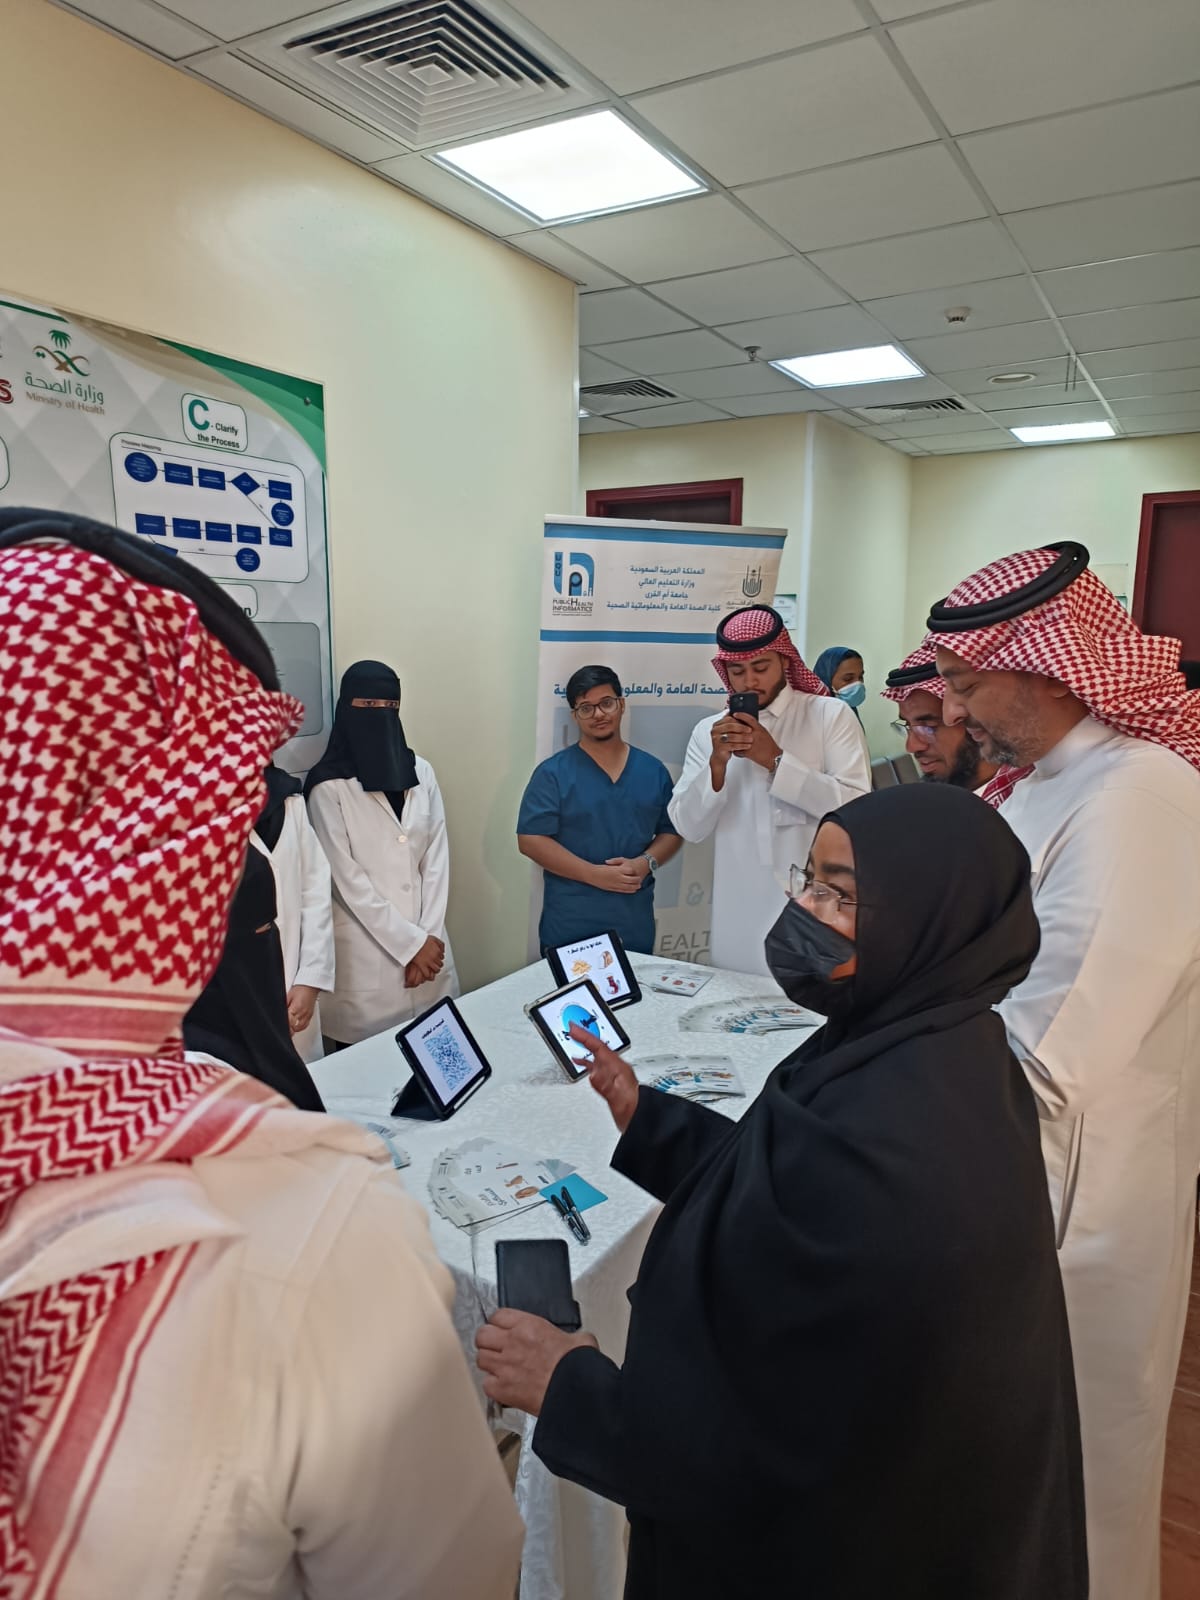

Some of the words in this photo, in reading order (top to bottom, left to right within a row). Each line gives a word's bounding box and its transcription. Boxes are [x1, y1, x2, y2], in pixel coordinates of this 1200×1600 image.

[25, 371, 71, 394] الصحة
[75, 383, 104, 405] وزارة
[26, 391, 63, 408] Ministry
[77, 403, 105, 415] Health
[188, 399, 210, 430] C
[215, 423, 239, 436] Clarify
[197, 433, 210, 443] the
[211, 436, 240, 449] Process
[630, 565, 658, 575] السعودية
[659, 565, 681, 575] العربية
[657, 578, 680, 588] التعليم
[671, 591, 689, 600] جامعة
[666, 683, 698, 696] العامة
